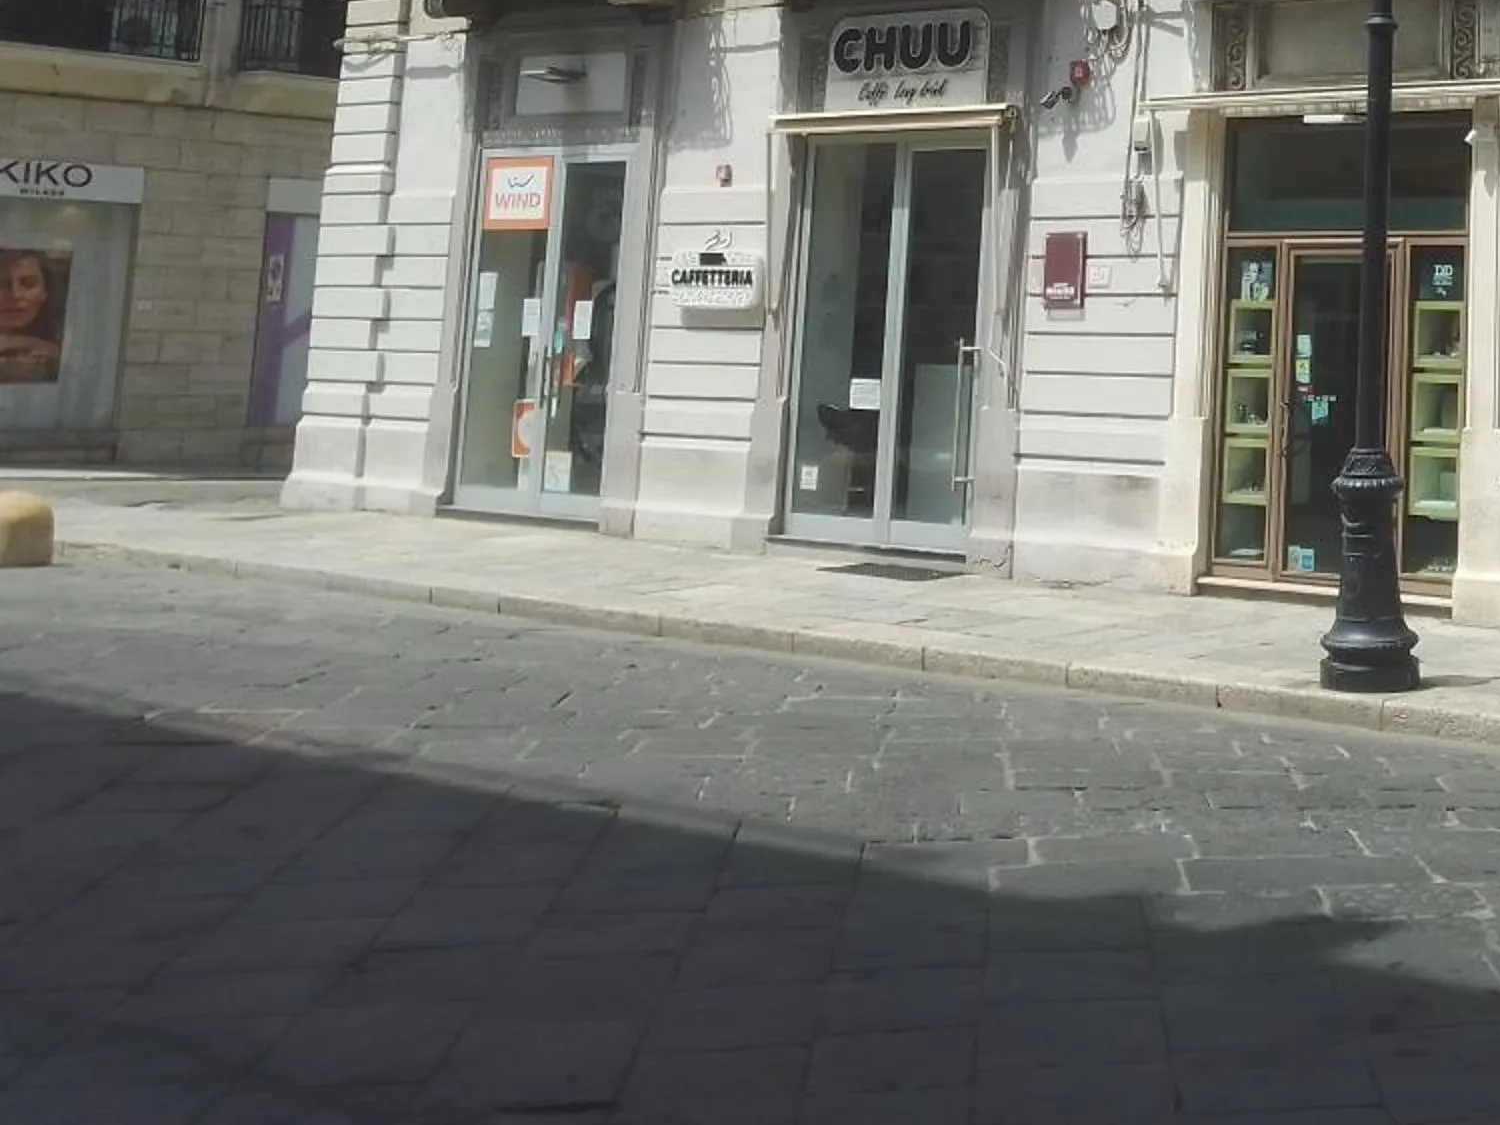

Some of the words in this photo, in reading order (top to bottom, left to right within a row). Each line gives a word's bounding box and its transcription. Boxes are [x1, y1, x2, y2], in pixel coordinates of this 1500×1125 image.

[834, 20, 971, 73] CHUU
[495, 192, 541, 208] WIND
[671, 269, 753, 286] CAFFETTERIA
